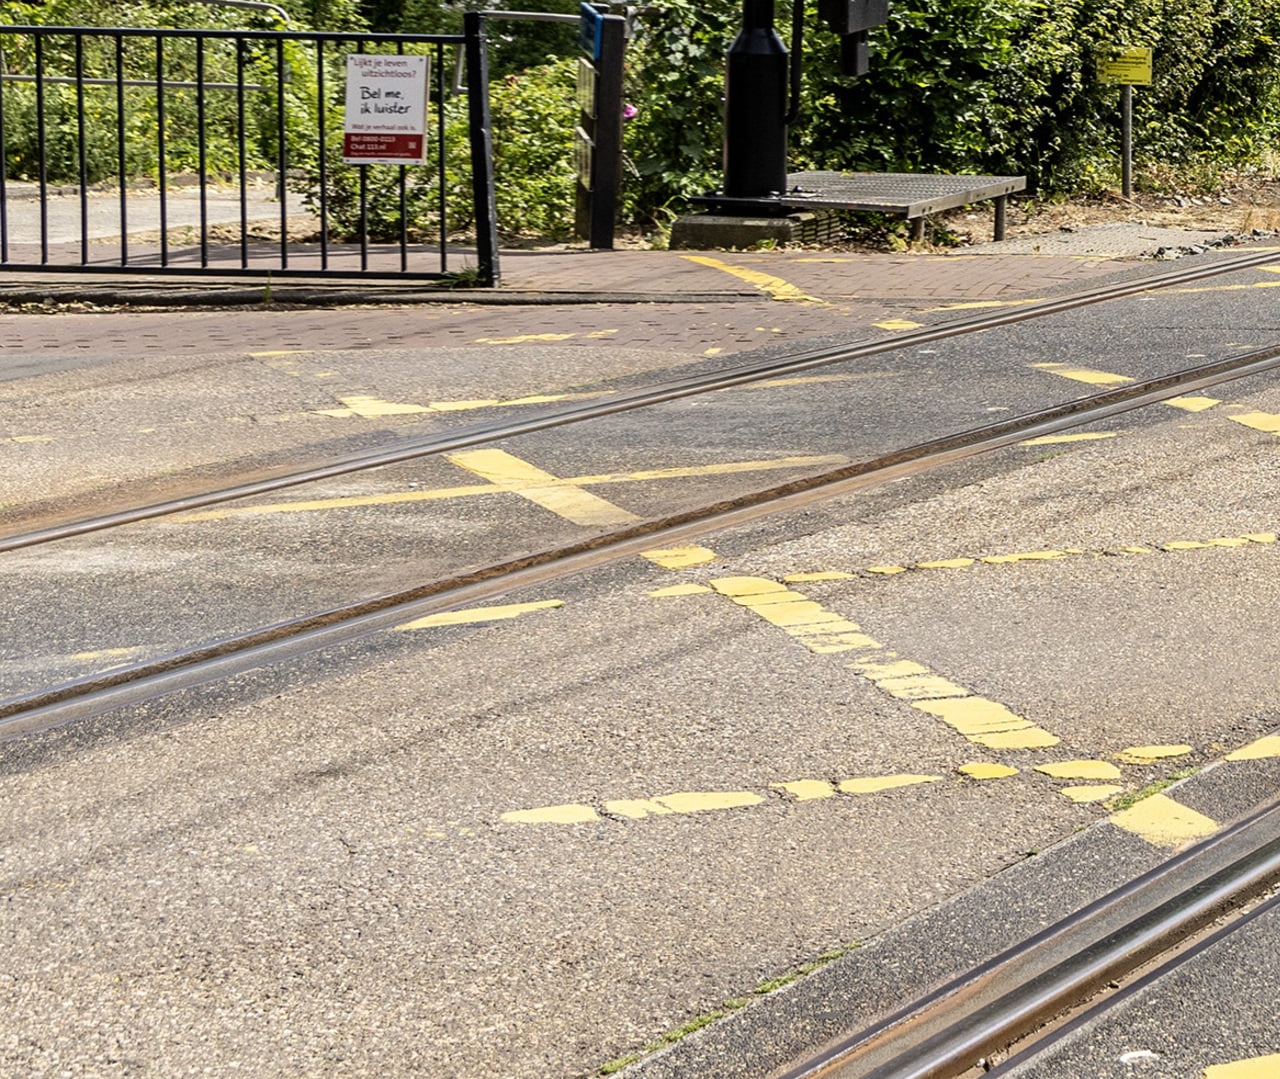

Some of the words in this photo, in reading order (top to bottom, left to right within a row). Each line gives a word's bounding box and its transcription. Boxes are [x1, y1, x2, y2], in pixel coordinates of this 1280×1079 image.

[354, 59, 372, 68] Lijkt
[373, 59, 382, 69] je
[384, 59, 408, 67] leven
[360, 86, 381, 100] Bel
[360, 102, 371, 114] ik
[374, 102, 411, 114] luister
